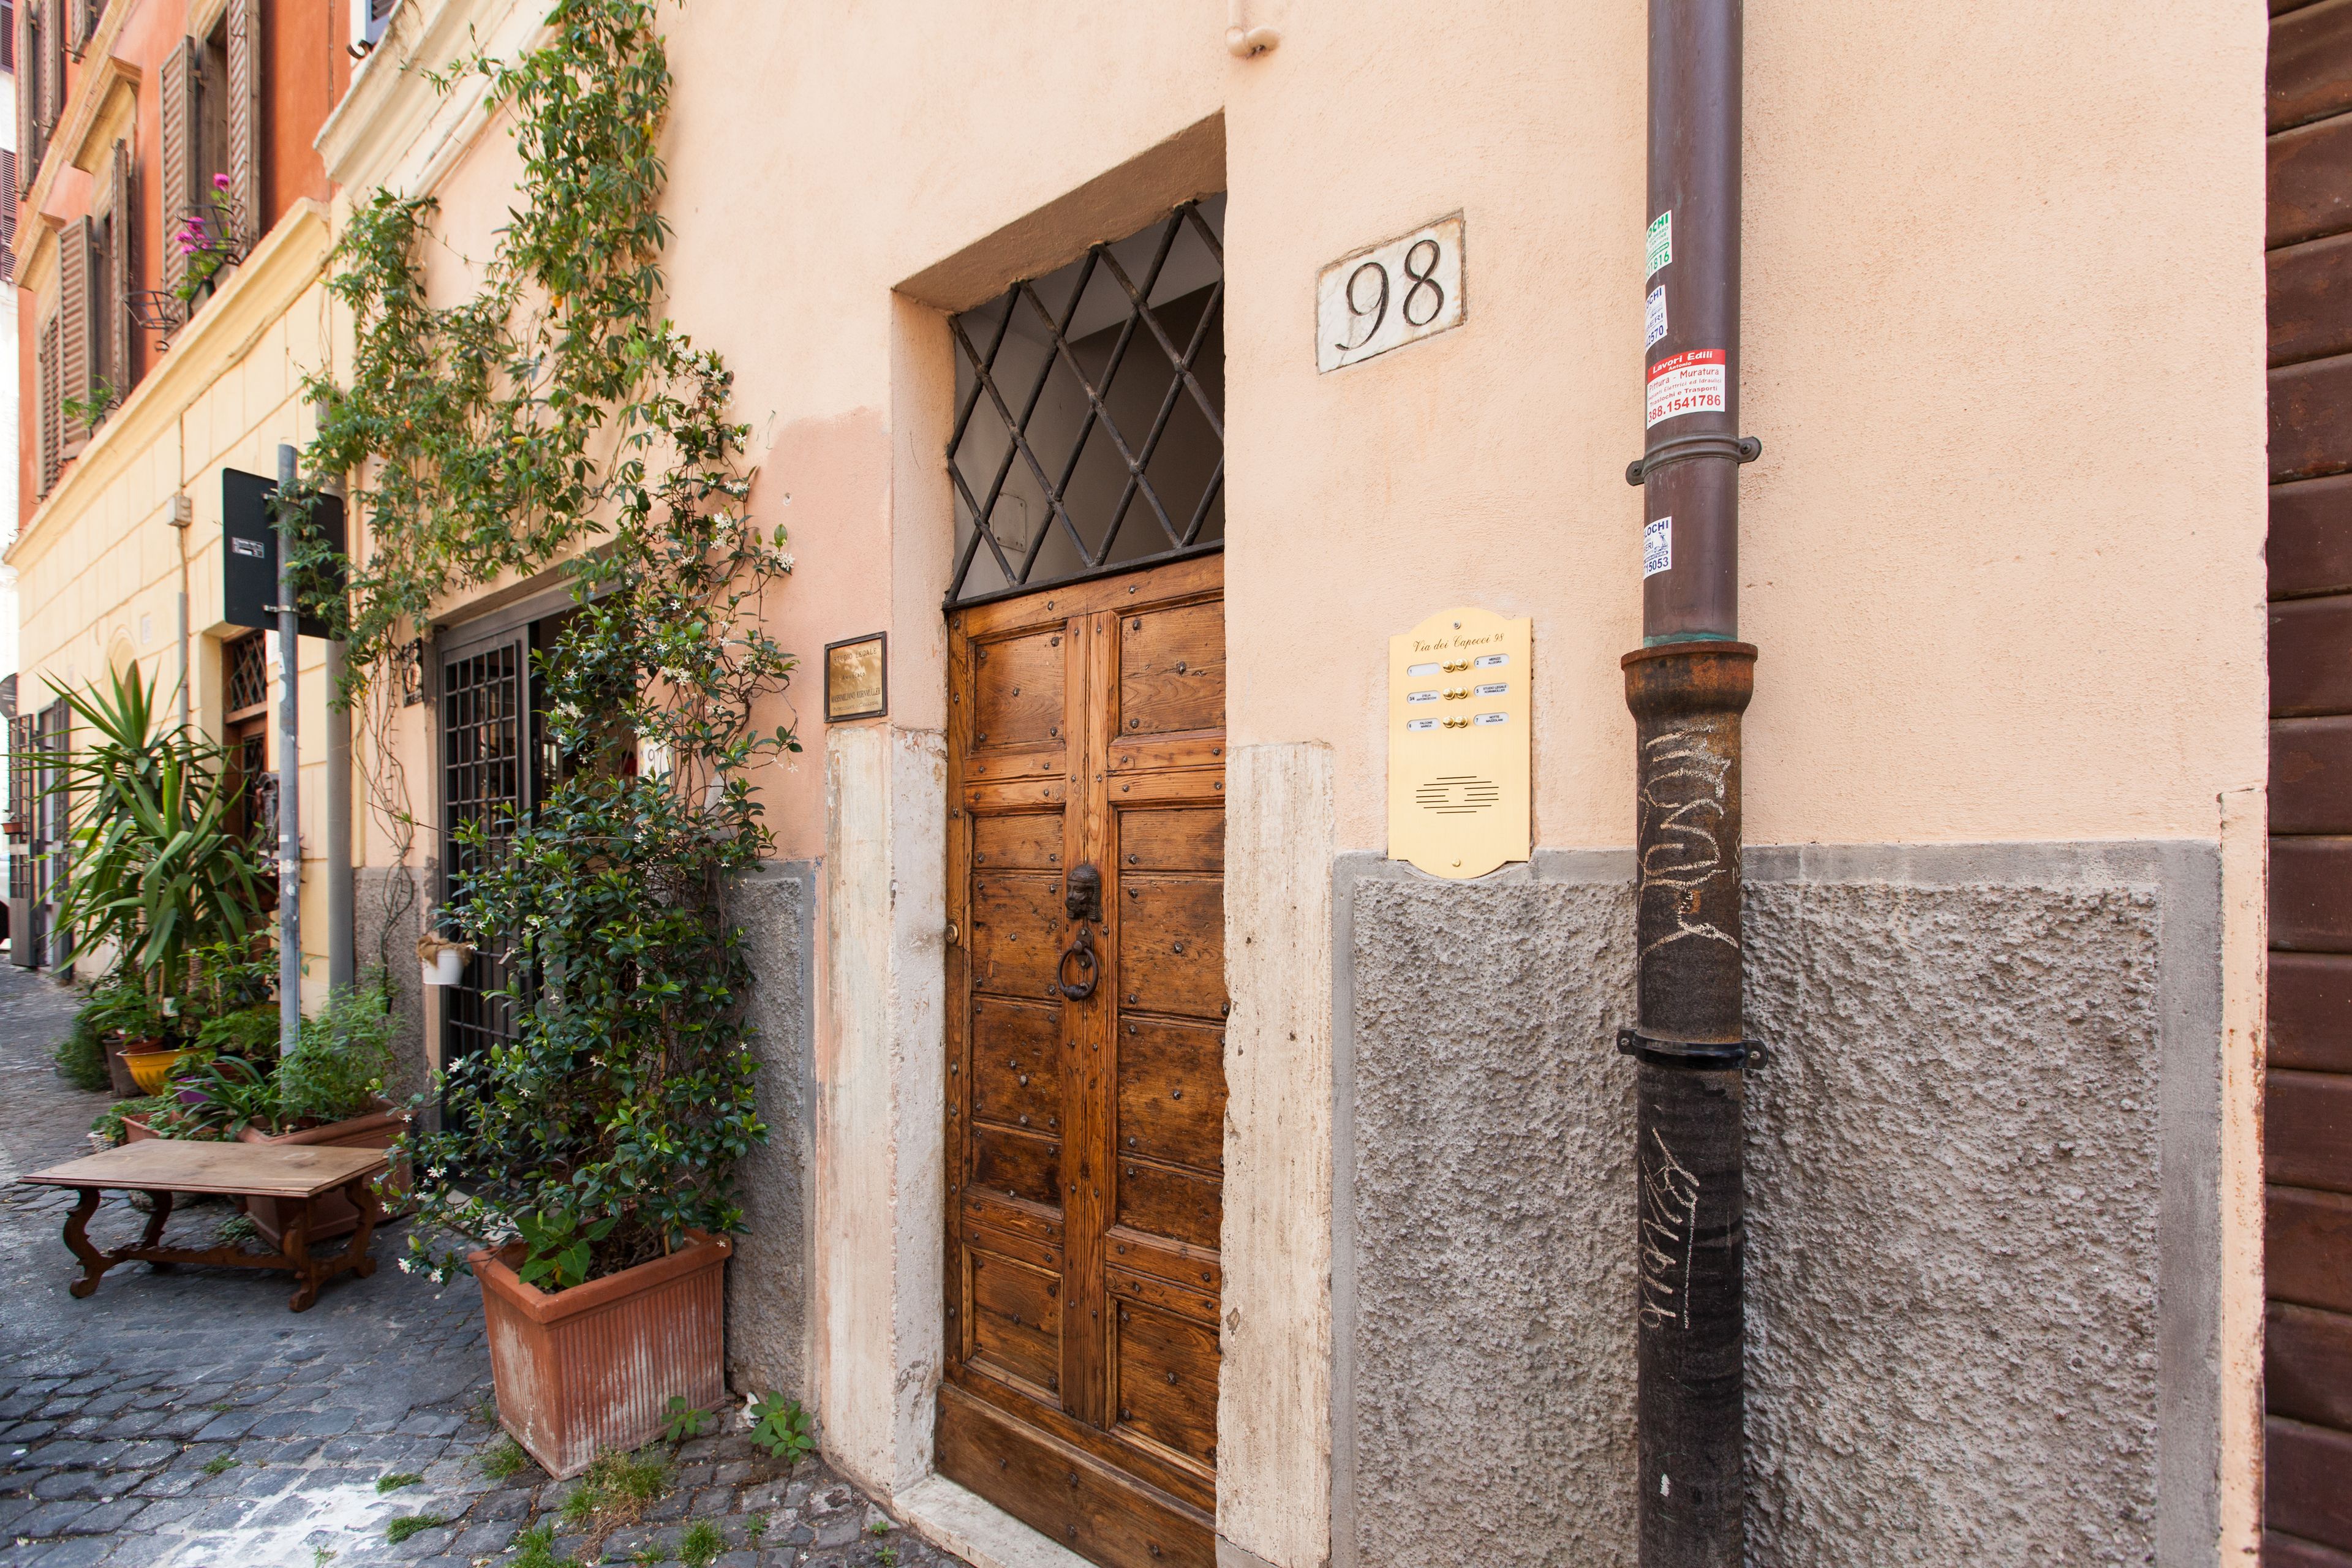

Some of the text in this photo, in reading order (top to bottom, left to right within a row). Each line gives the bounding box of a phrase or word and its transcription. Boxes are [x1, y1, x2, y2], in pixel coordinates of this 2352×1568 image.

[1335, 239, 1444, 351] 98
[1653, 351, 1713, 374] Lavori Edili
[1668, 361, 1692, 371] Antonio
[1649, 377, 1670, 393] Pittura
[1680, 368, 1719, 379] Muratura
[1664, 381, 1687, 392] Elettrici
[1649, 391, 1675, 407] Traslochi
[1684, 385, 1717, 394] Trasporti
[1648, 394, 1721, 423] 388.1541786
[1412, 633, 1504, 652] Via dei Capocci 98
[833, 647, 877, 663] STUDIO LEGALE
[831, 692, 856, 703] MASSIMILIANO
